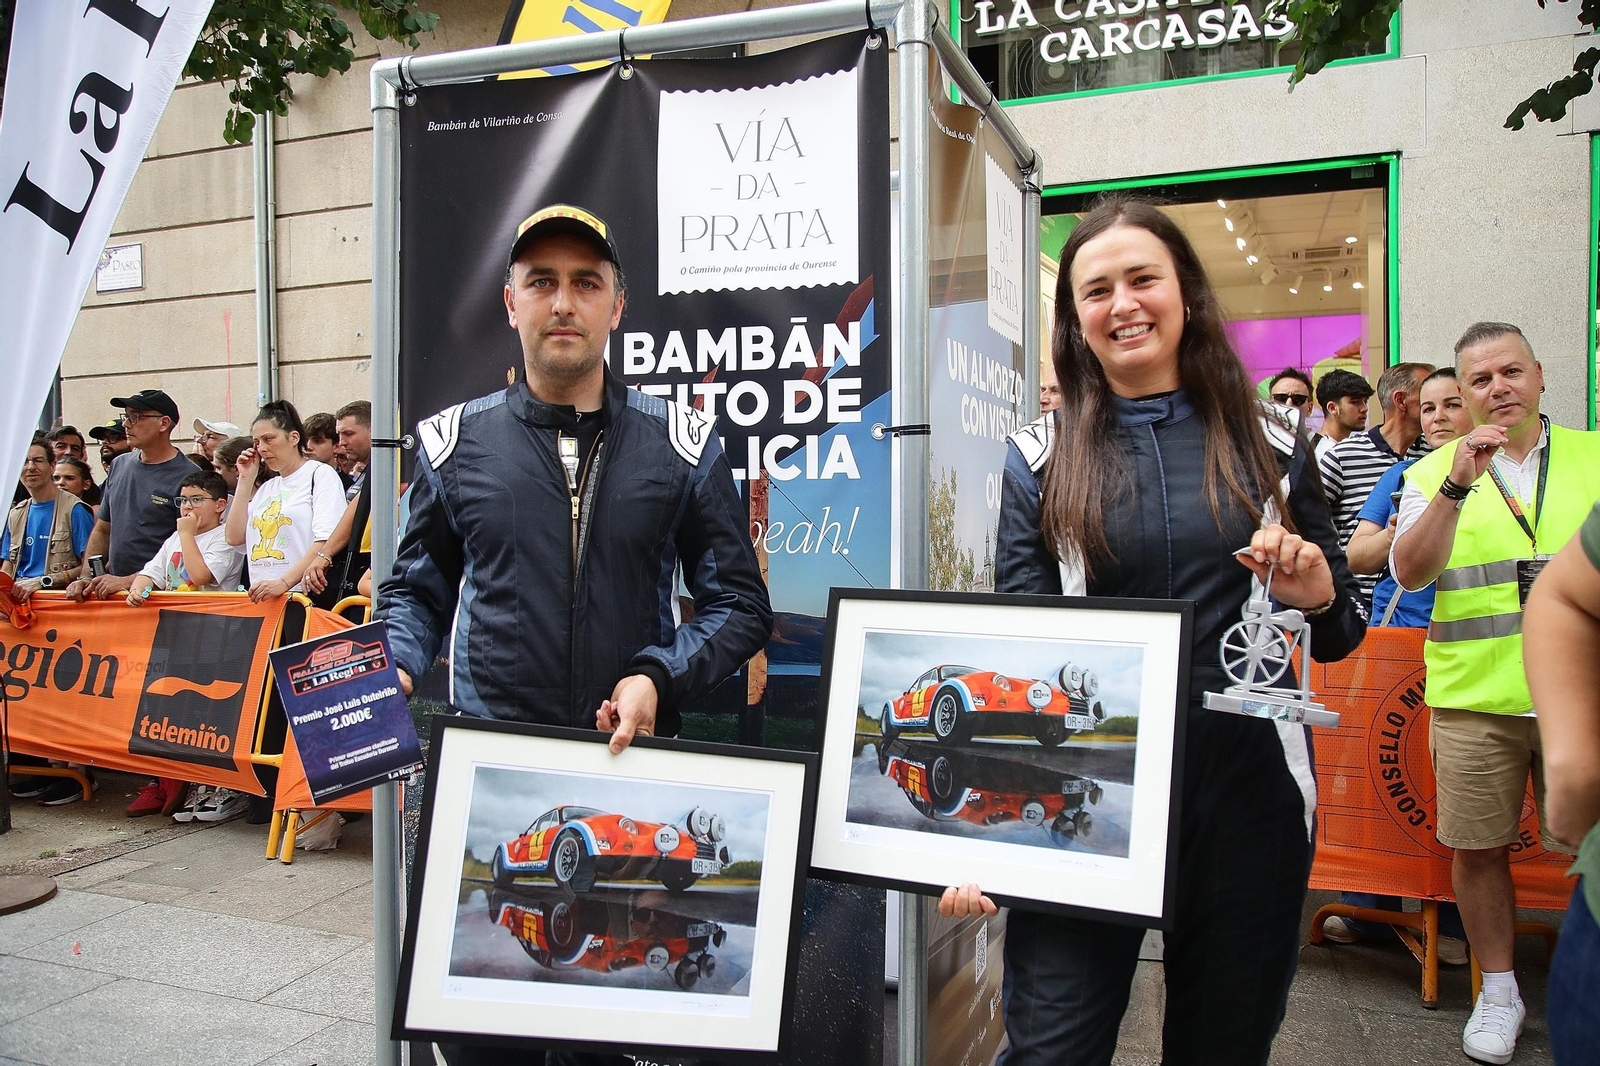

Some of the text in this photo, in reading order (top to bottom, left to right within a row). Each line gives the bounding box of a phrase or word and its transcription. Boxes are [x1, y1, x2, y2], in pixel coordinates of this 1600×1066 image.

[974, 0, 1039, 36] LA
[1040, 1, 1296, 64] CARCASAS
[427, 119, 467, 132] Bambán
[469, 118, 480, 129] de
[483, 114, 521, 128] Vilariño
[523, 113, 534, 125] de
[713, 108, 807, 164] VÍA
[3, 70, 134, 255] La
[737, 172, 781, 201] DA
[679, 208, 835, 254] PRATA
[995, 192, 1013, 242] VÍA
[680, 259, 837, 275] O Camiño pola provincia de Ourense
[990, 265, 1019, 315] PRATA
[946, 338, 1023, 407] UN ALMORZO
[783, 377, 862, 425] DE
[961, 392, 987, 437] CON
[311, 642, 353, 667] 59
[312, 674, 328, 687] La
[331, 663, 366, 683] Región
[292, 686, 398, 726] Premio José Luis Outeiriño
[330, 707, 373, 731] 2.000€
[139, 714, 231, 754] telemiño
[387, 771, 398, 780] La
[1378, 710, 1427, 828] CONSELLO
